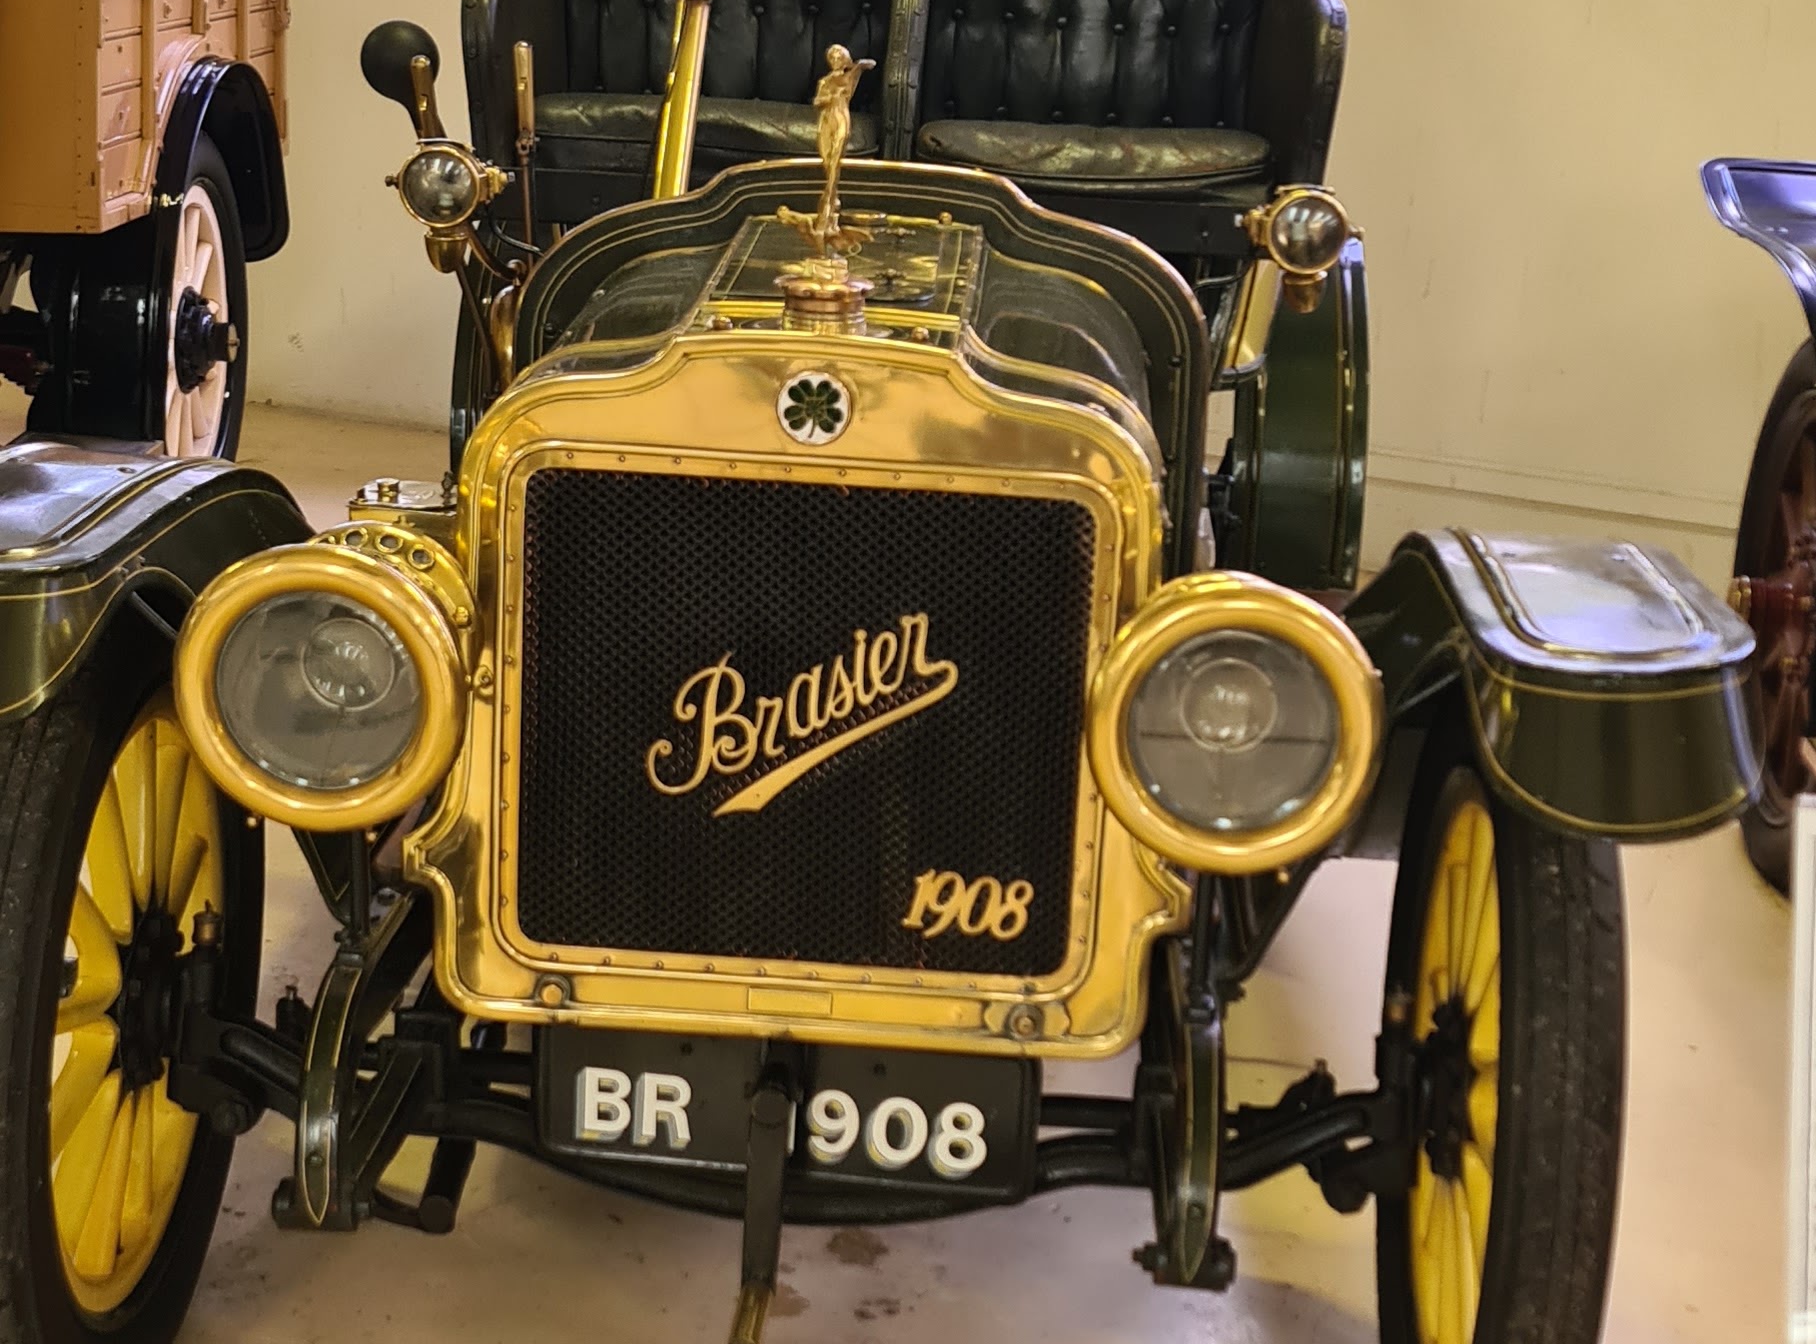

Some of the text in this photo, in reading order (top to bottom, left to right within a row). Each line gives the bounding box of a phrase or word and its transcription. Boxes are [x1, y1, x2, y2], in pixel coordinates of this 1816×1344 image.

[646, 612, 958, 815] Brasier
[902, 869, 1033, 940] 1908
[575, 1067, 692, 1148] BR
